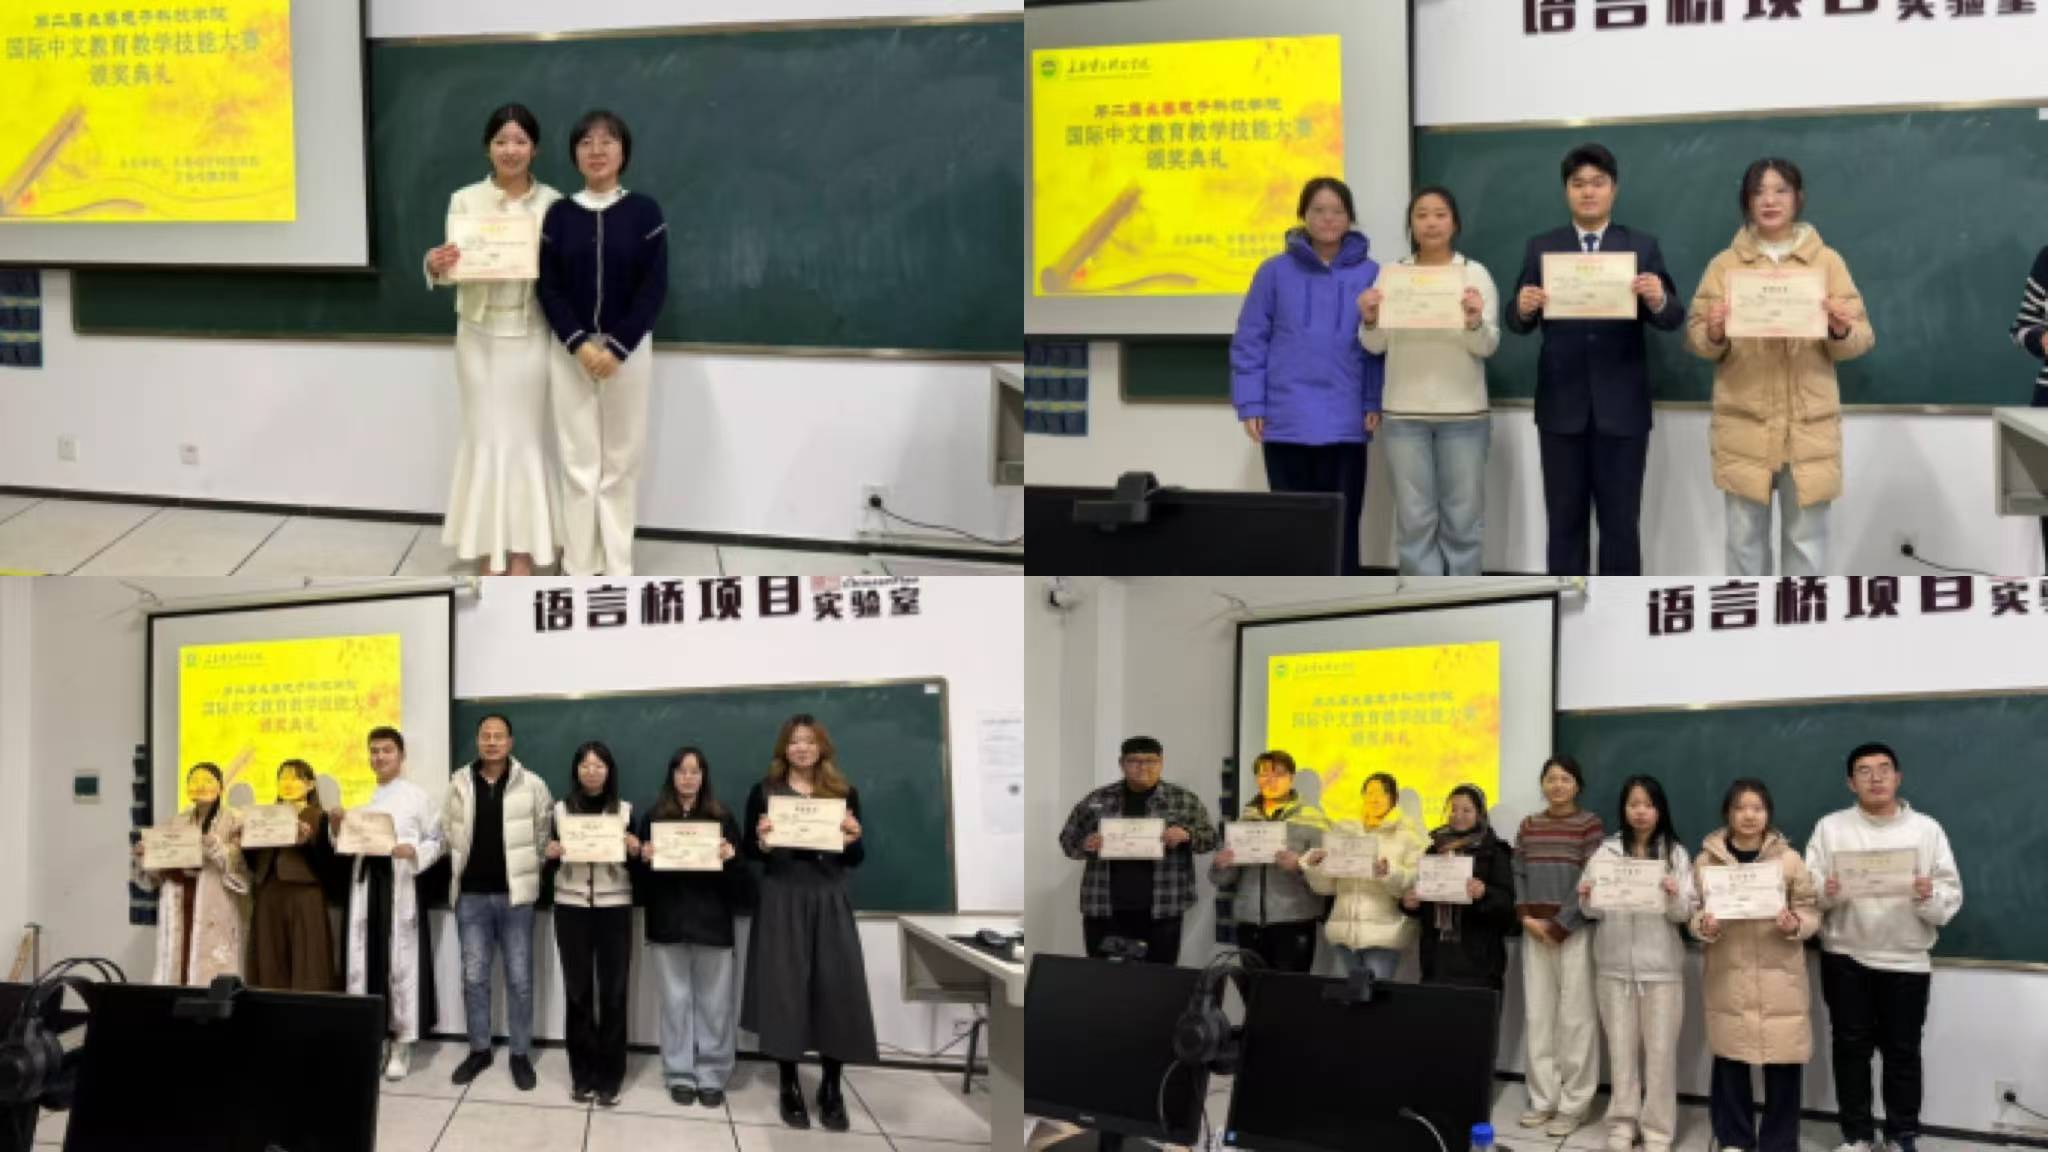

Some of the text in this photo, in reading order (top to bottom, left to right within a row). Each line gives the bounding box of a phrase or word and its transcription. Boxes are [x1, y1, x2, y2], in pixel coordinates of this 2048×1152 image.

[89, 62, 174, 86] 颁奖典礼
[1146, 148, 1229, 170] 颁奖典礼
[533, 577, 799, 632] 语言桥项目
[814, 587, 920, 621] 实验室
[1992, 581, 2048, 618] 实
